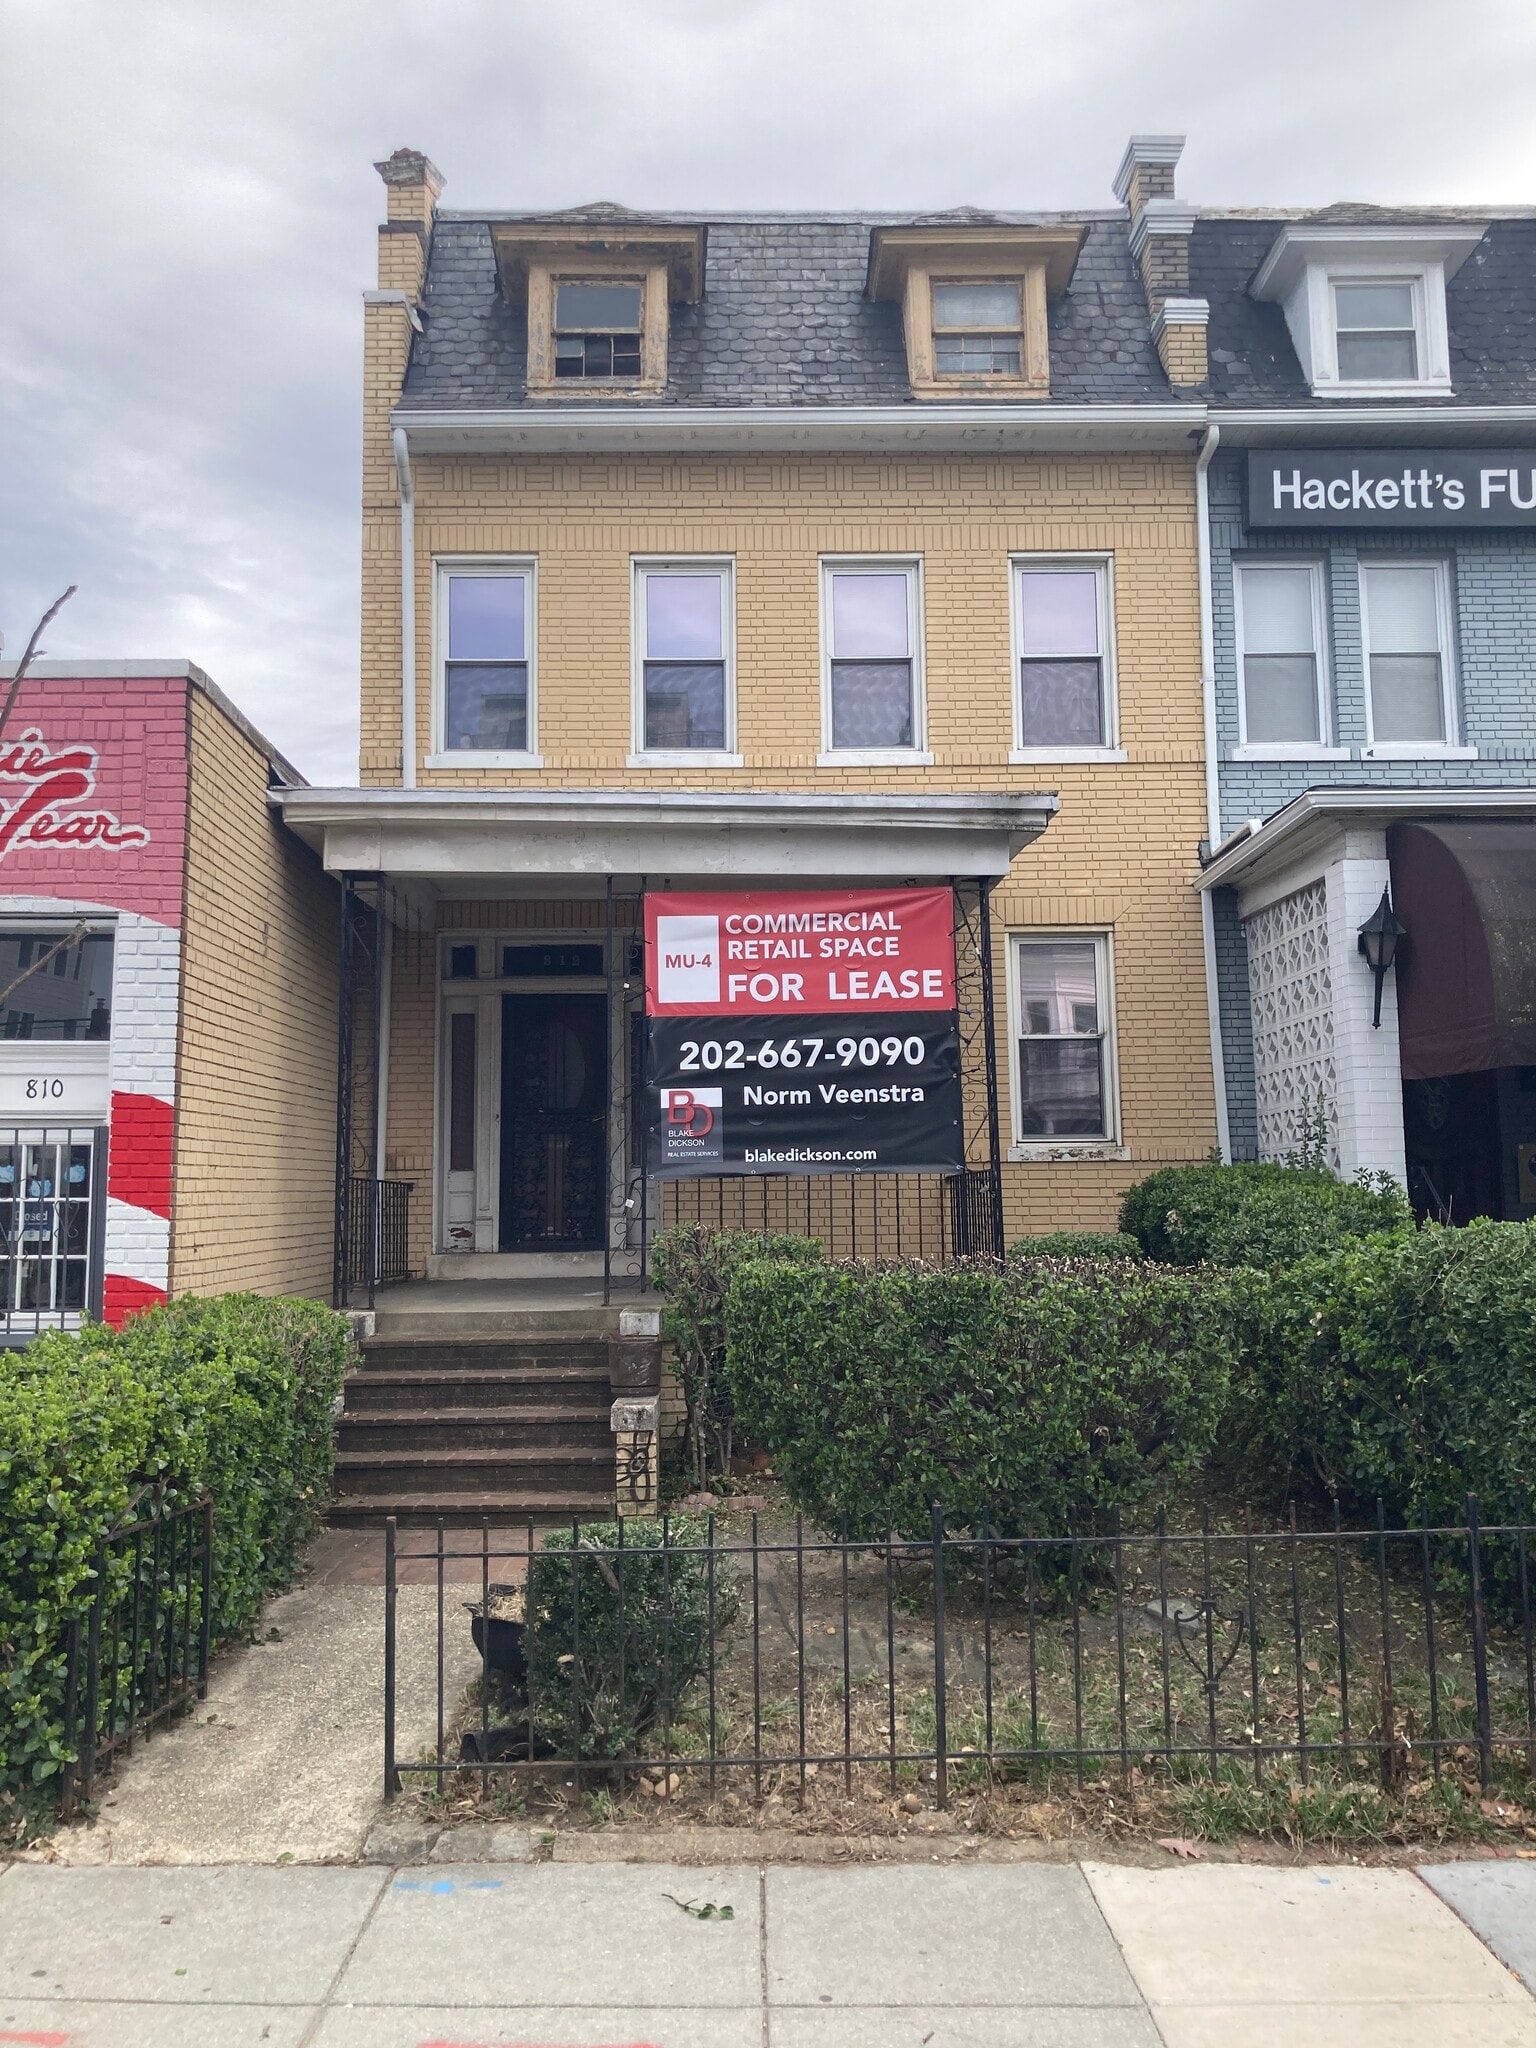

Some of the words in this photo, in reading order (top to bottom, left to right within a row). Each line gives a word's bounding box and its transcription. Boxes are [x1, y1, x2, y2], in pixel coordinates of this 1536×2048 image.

[1273, 469, 1465, 510] Hackett’s
[725, 911, 901, 935] COMMERCIAL
[728, 939, 812, 960] RETAIL
[819, 936, 900, 958] SPACE
[665, 953, 713, 969] MU-4
[728, 972, 805, 1002] FOR
[828, 969, 944, 1000] LEASE
[679, 1036, 926, 1071] 202-667-9090
[26, 1079, 64, 1099] 810
[743, 1085, 811, 1106] Norm
[818, 1084, 925, 1104] Veenstra
[668, 1129, 694, 1137] BLAKE
[668, 1139, 705, 1147] DICKSON
[745, 1147, 877, 1163] blakedickson.com
[15, 1210, 49, 1221] Cosed
